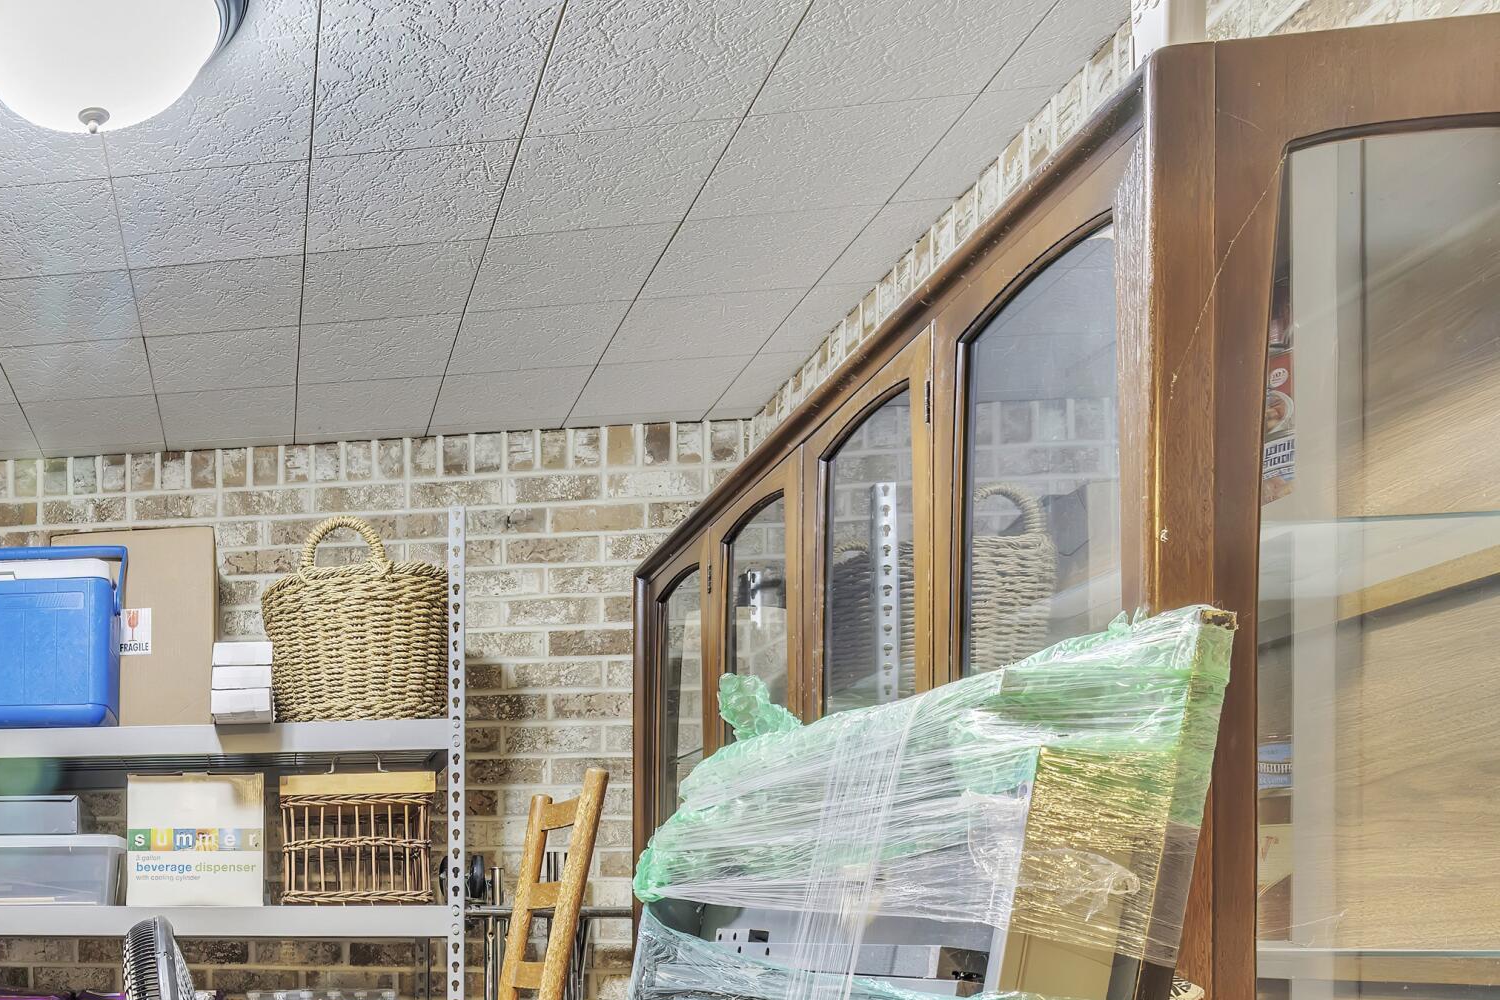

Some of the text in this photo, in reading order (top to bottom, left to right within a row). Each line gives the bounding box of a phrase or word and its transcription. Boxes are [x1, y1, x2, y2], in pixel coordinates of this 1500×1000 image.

[120, 643, 149, 653] FRAGILE
[134, 831, 258, 848] summer
[136, 862, 257, 874] beverage dispenser
